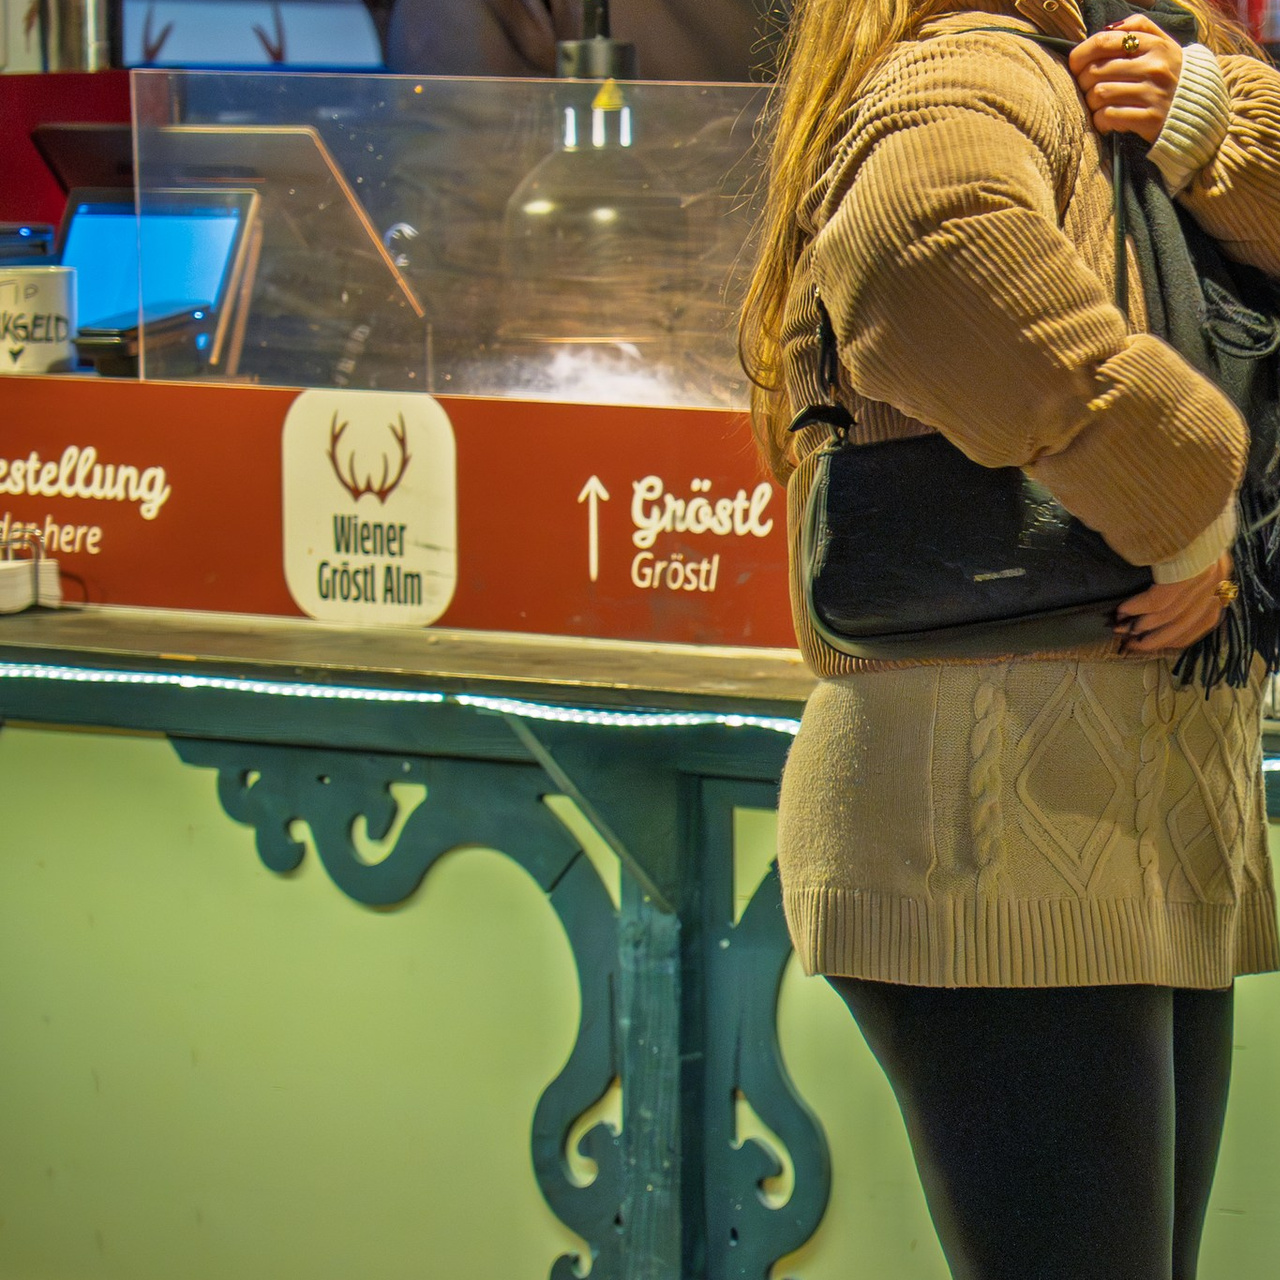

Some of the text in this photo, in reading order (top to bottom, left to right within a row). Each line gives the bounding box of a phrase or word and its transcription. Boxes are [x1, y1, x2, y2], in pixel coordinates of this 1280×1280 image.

[0, 445, 171, 520] estellung
[631, 475, 774, 549] Gröstl
[45, 514, 102, 555] here
[333, 514, 407, 557] Wiener
[318, 560, 423, 606] Gröstl Alm
[631, 551, 720, 592] Gröstl
